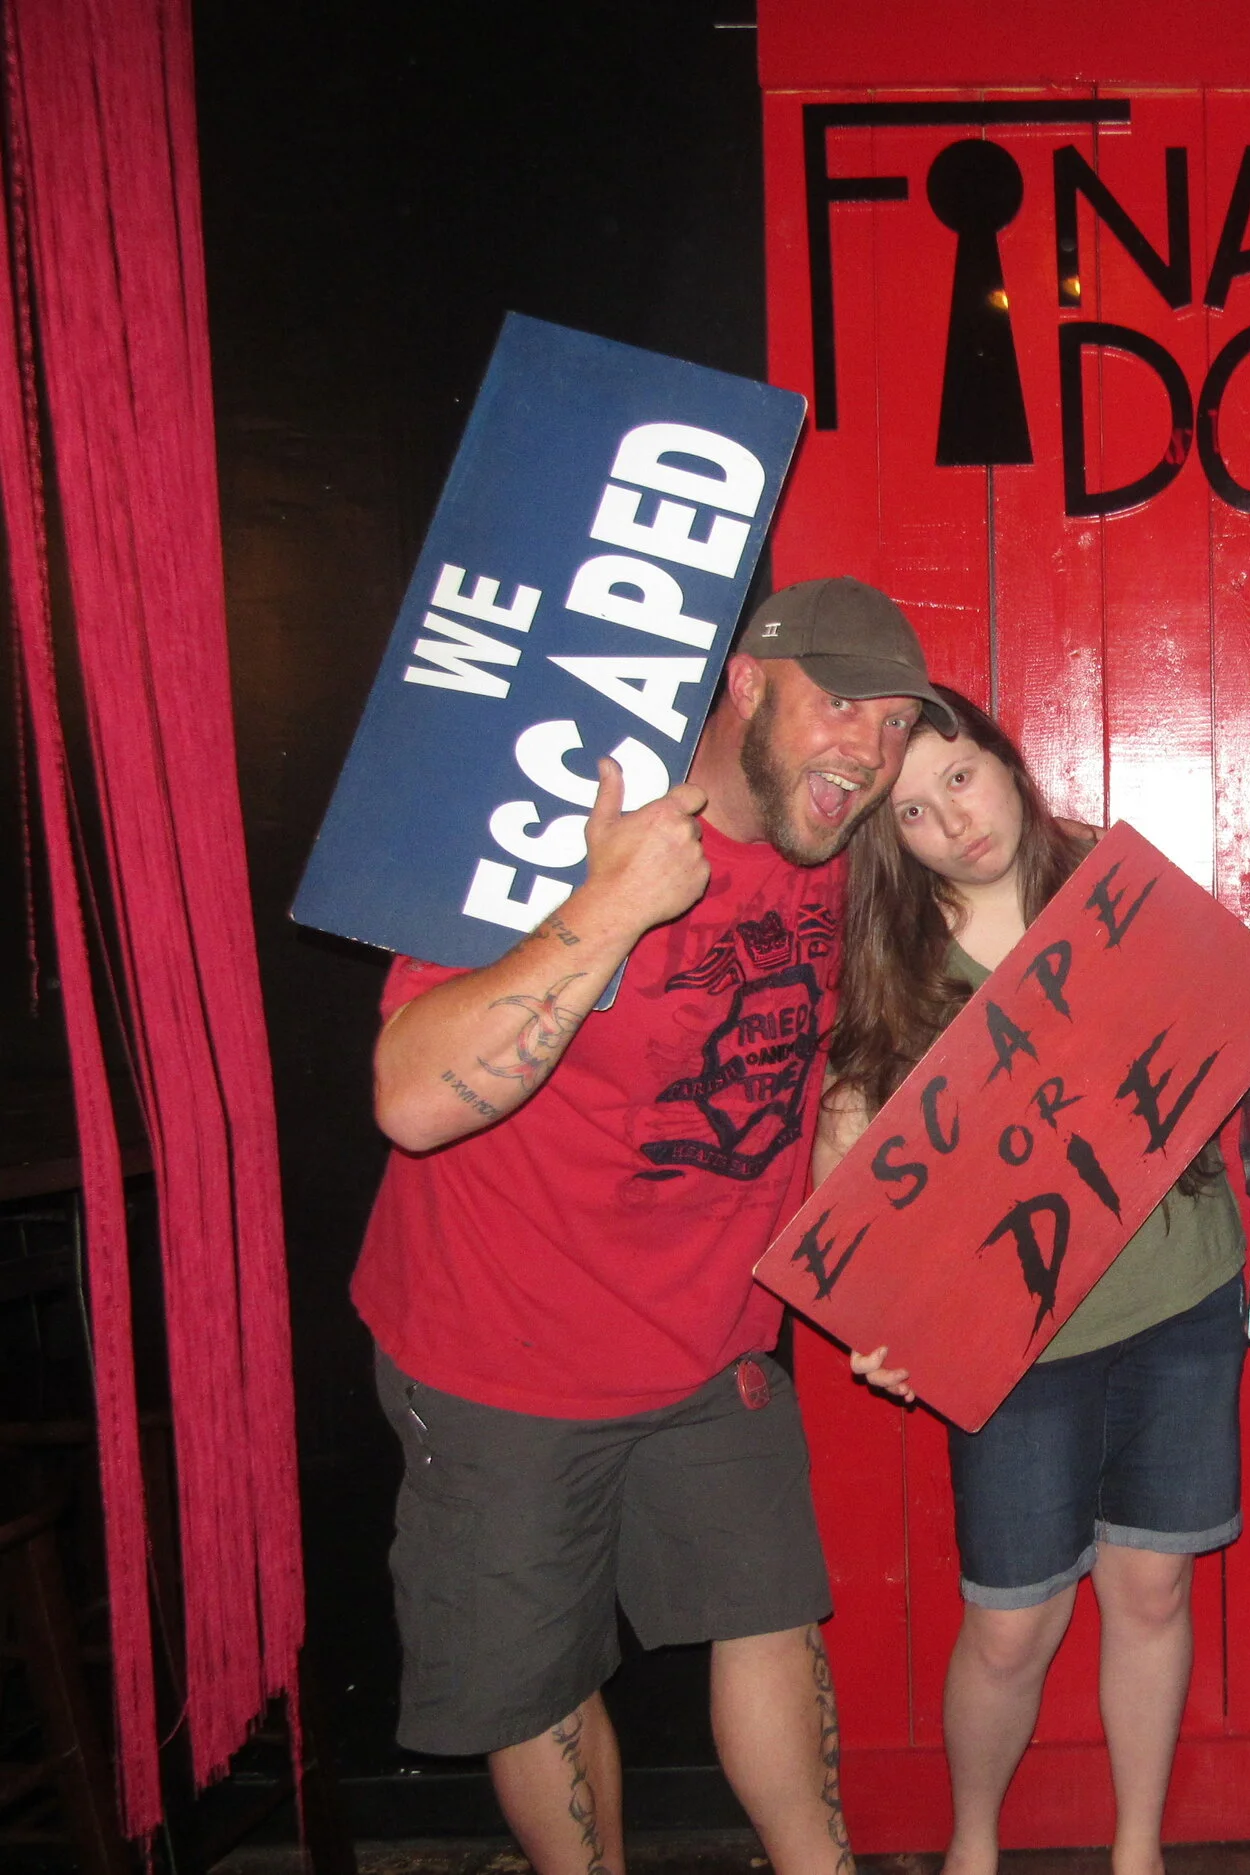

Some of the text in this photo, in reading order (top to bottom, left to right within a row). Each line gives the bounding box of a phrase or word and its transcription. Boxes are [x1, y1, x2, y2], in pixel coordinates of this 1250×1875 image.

[403, 563, 542, 699] WE
[461, 422, 766, 934] ESCAPED
[736, 1003, 809, 1047] TRIED
[790, 856, 1165, 1301] ESCAPE
[998, 1076, 1084, 1166] OR
[975, 1020, 1229, 1359] DIE
